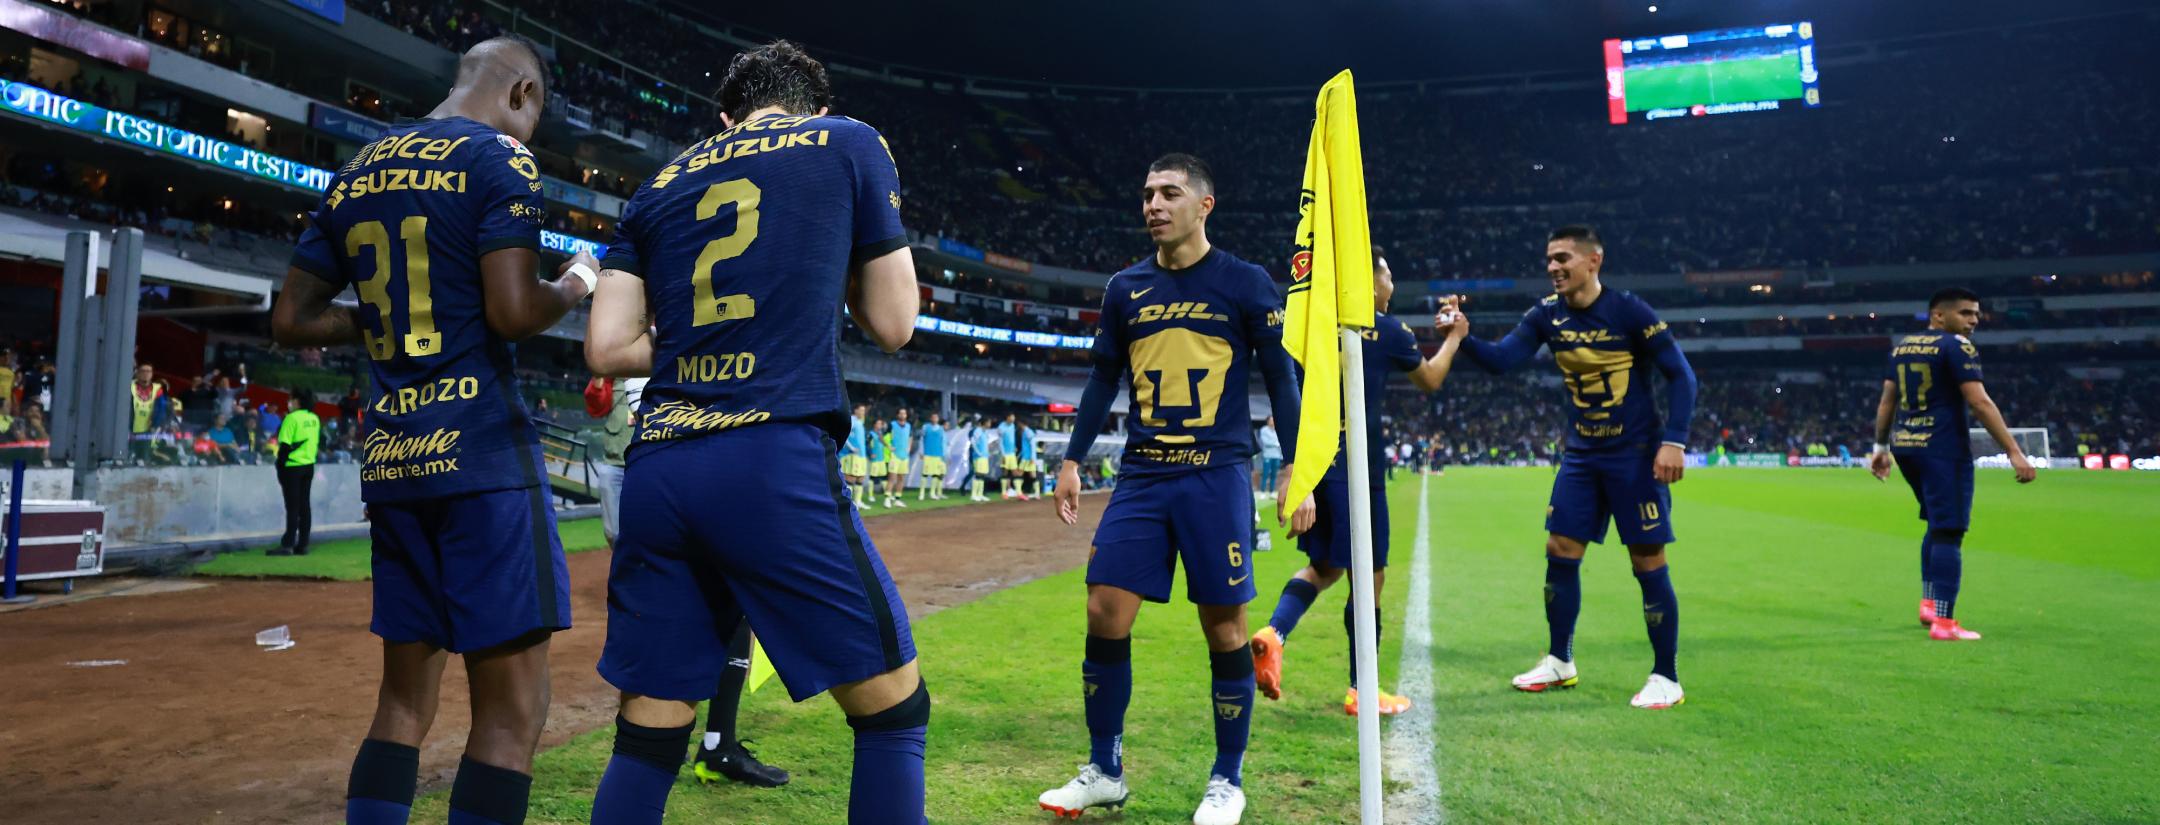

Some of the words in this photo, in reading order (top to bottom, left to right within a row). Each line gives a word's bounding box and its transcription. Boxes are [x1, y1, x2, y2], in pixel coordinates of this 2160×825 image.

[686, 130, 830, 174] SUZUKI
[349, 168, 467, 199] SUZUKI
[691, 177, 762, 328] 2
[345, 215, 442, 361] 31
[1136, 301, 1216, 324] DHL
[676, 352, 757, 384] MOZO
[1897, 363, 1932, 411] 17
[361, 428, 461, 468] Caliente
[640, 426, 683, 441] cali
[362, 457, 460, 482] caliente.mx
[1165, 449, 1211, 466] Mifel
[1639, 502, 1659, 520] 10
[1227, 542, 1243, 567] 6
